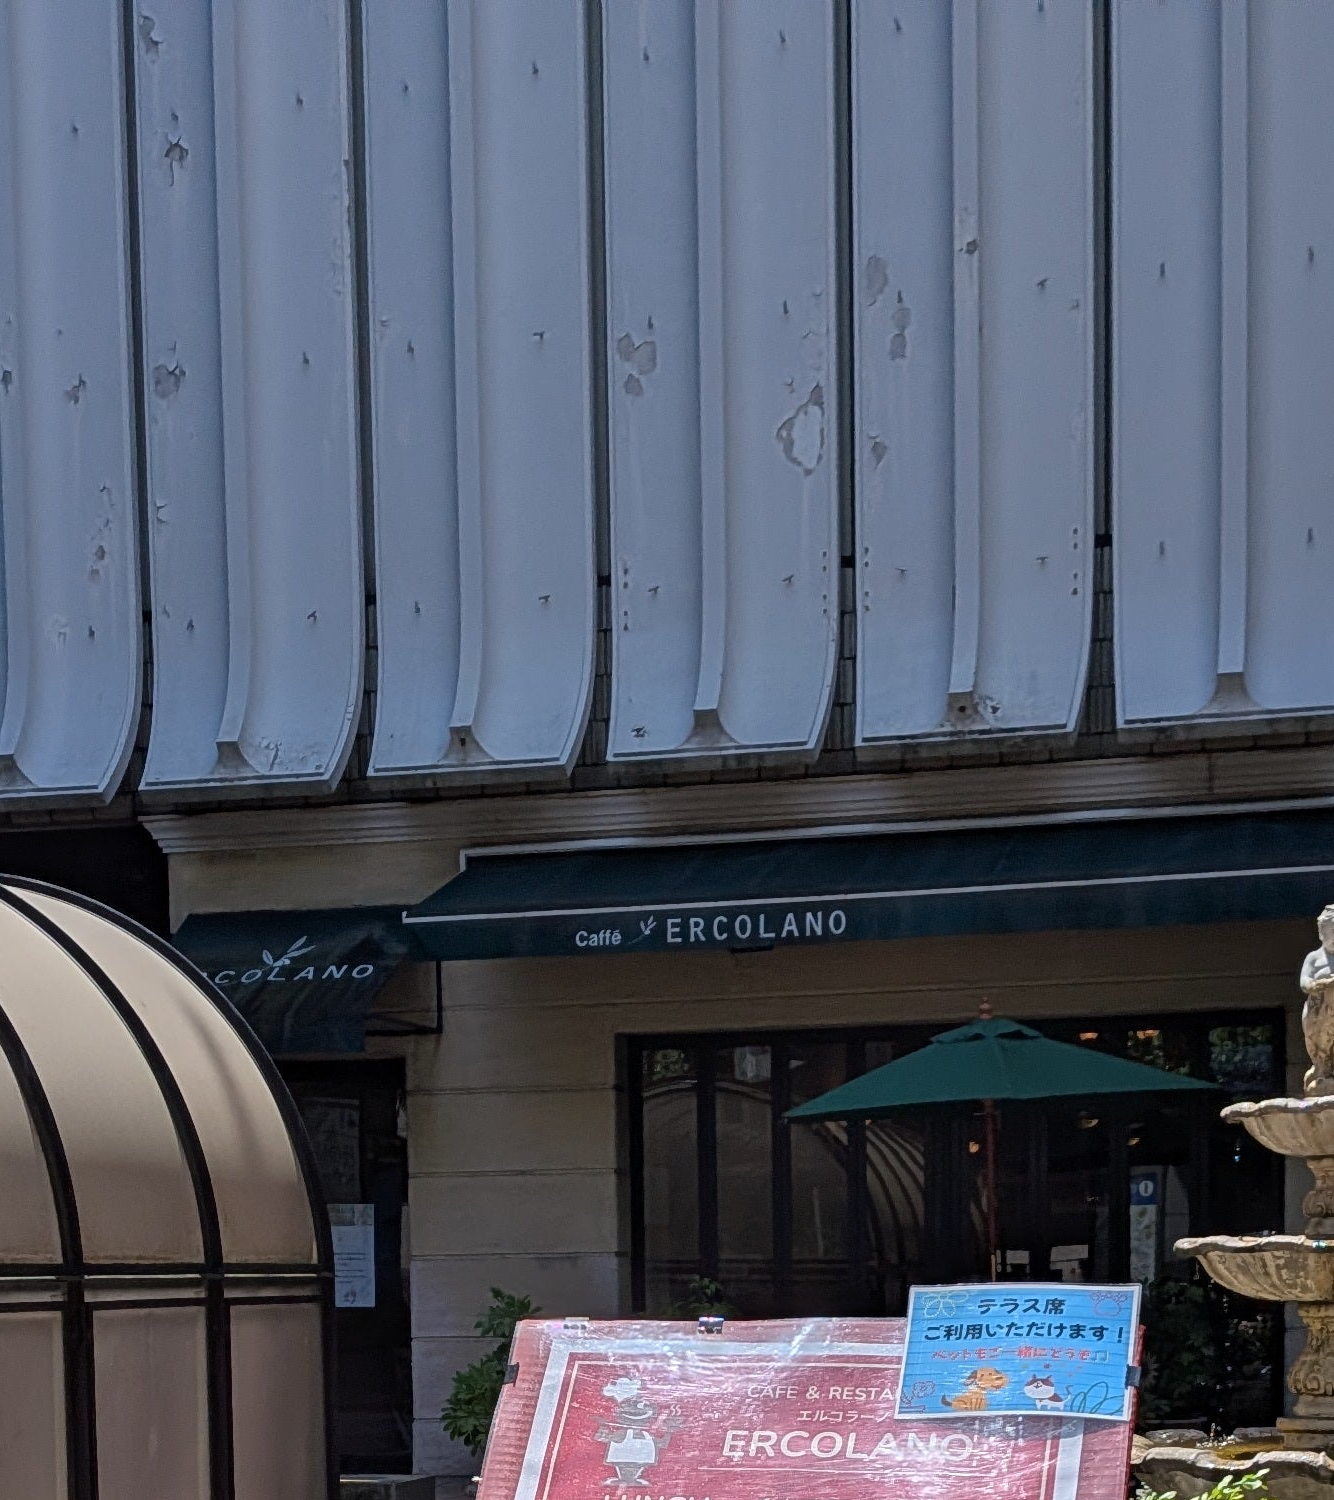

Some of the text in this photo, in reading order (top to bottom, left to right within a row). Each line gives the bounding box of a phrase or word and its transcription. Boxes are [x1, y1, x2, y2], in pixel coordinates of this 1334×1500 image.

[666, 909, 847, 943] ERCOLANO
[201, 963, 375, 985] COLANO
[977, 1298, 1067, 1316] テラス席
[747, 1385, 799, 1400] CAFE
[805, 1386, 822, 1401] &
[721, 1429, 974, 1462] ERCOLANO
